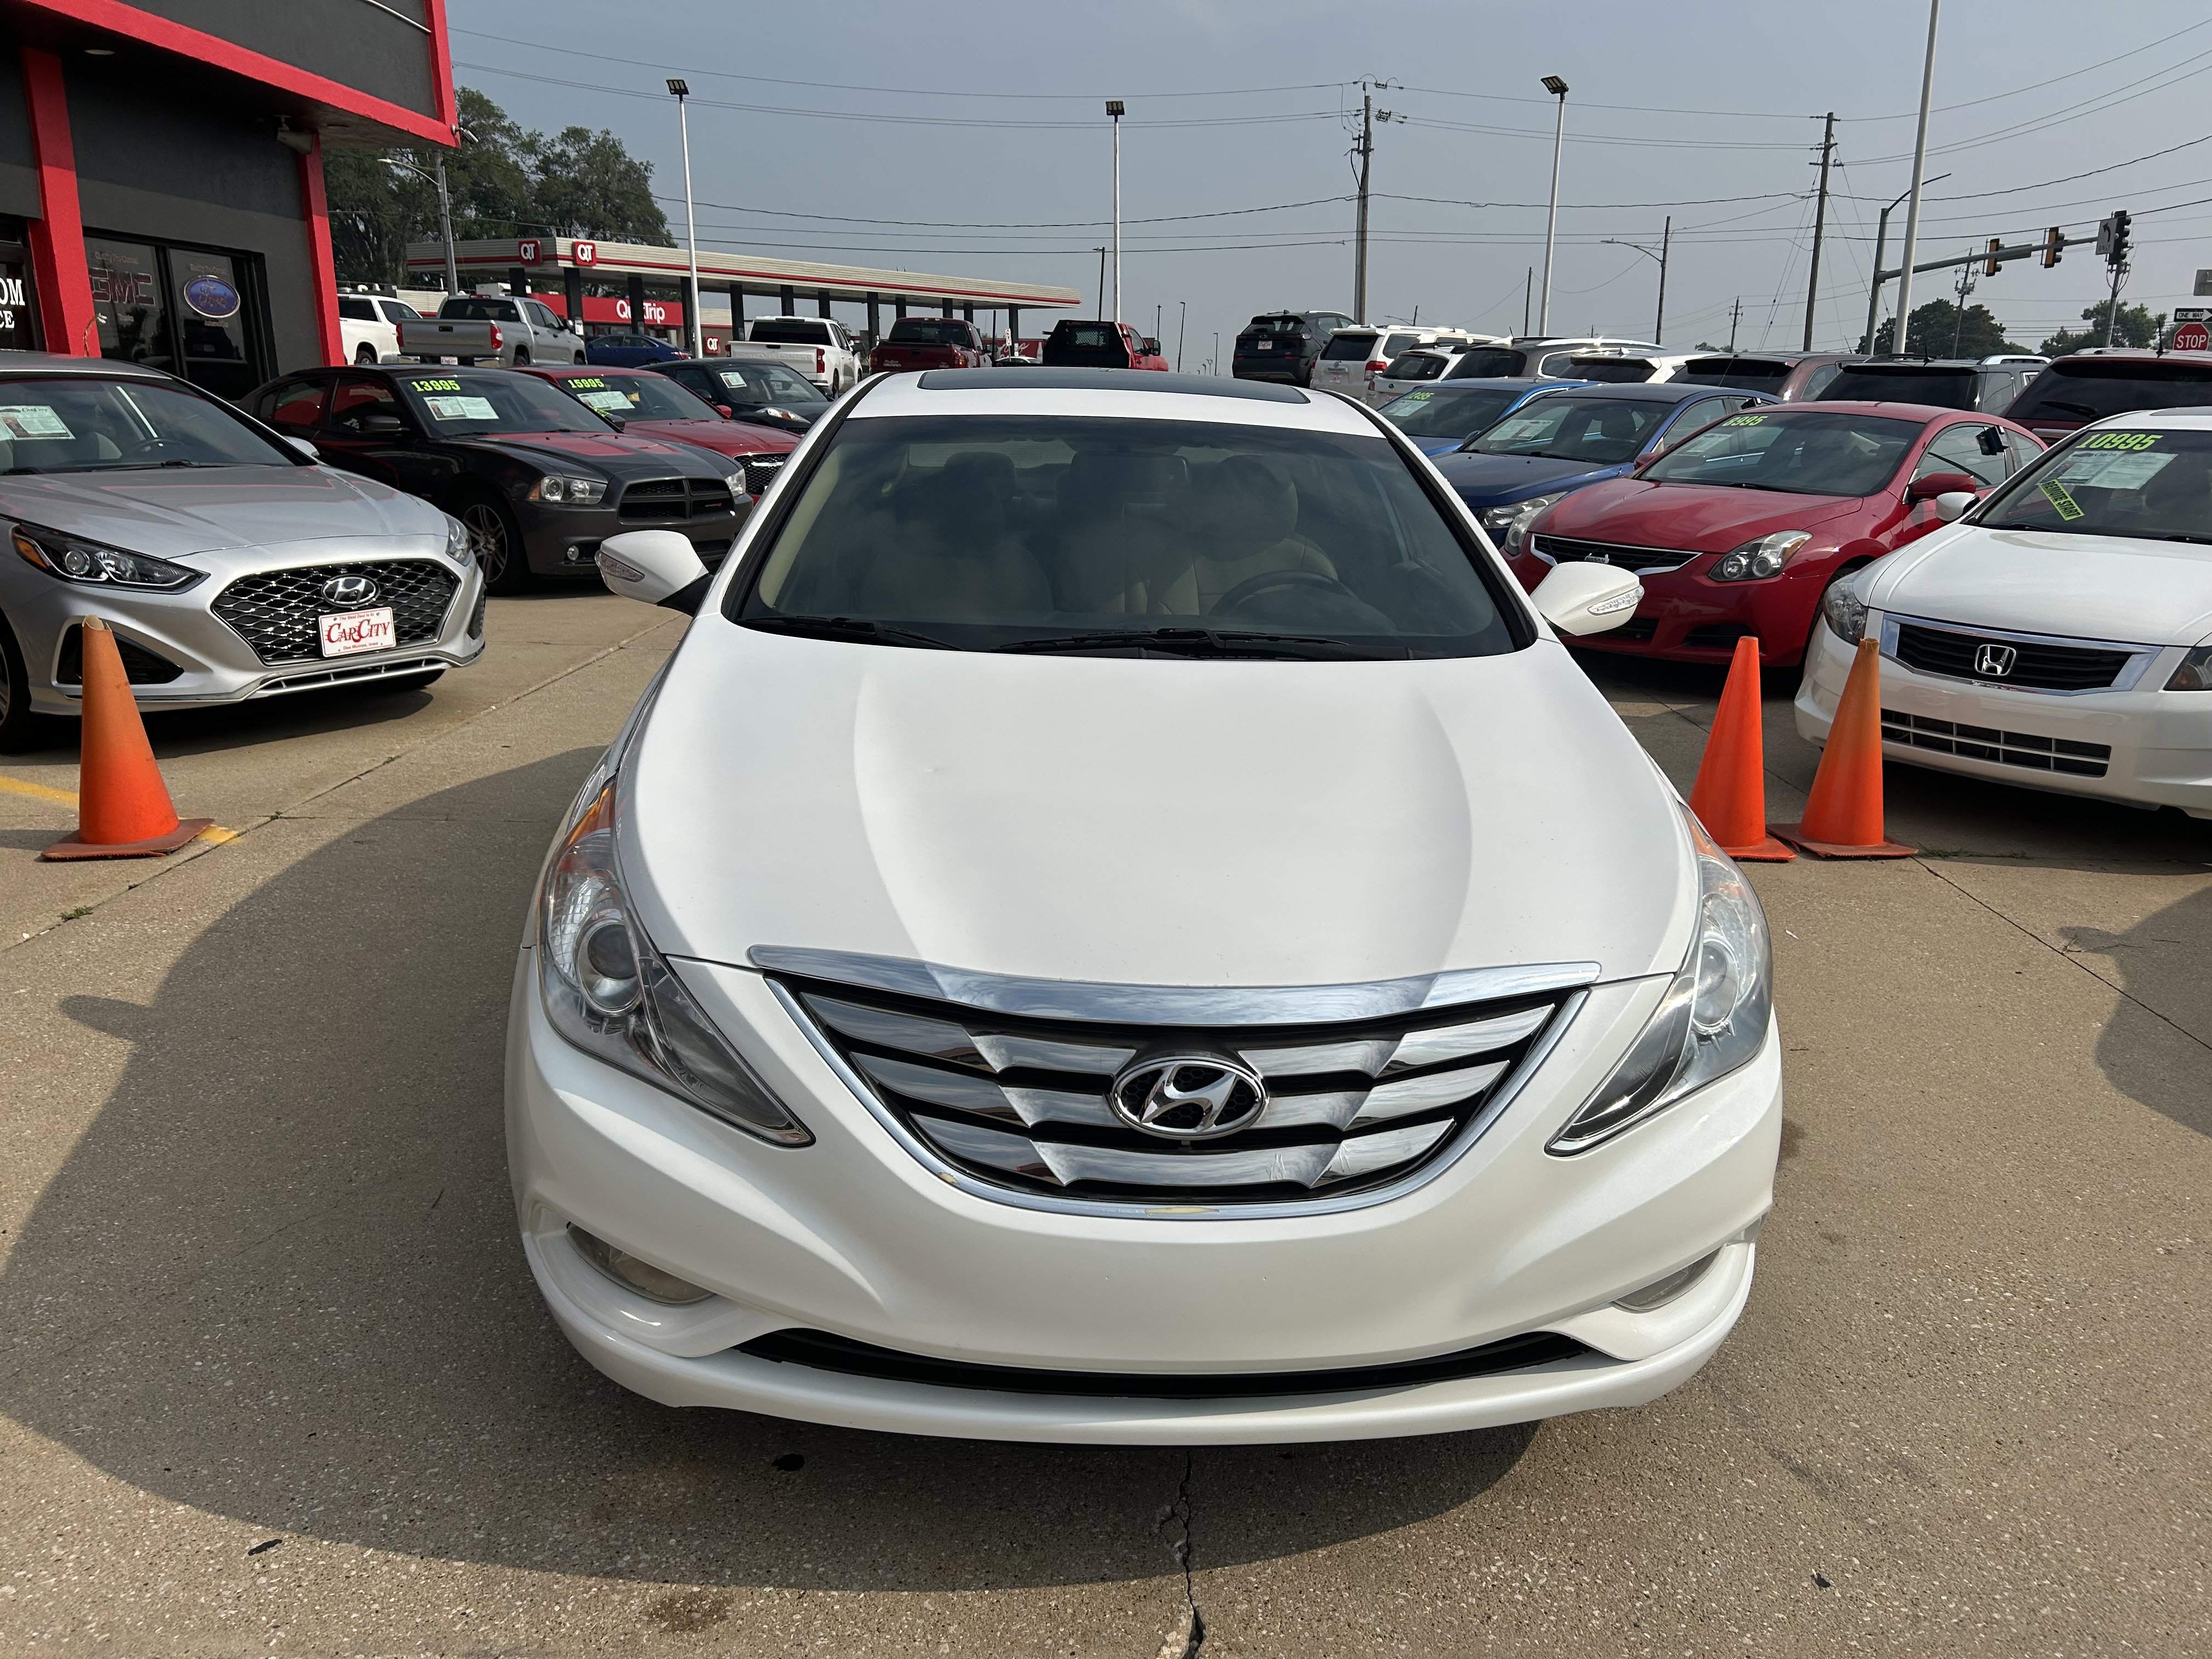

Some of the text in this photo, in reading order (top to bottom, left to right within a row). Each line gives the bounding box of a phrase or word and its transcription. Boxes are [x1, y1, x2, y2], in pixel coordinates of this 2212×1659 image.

[521, 243, 535, 261] QT
[577, 244, 594, 262] QT
[2098, 244, 2112, 252] ONLY
[88, 267, 156, 306] GMC
[616, 299, 665, 324] QTrip
[707, 337, 719, 351] QT
[2176, 335, 2207, 348] STOP
[411, 380, 461, 392] 13995
[1722, 416, 1769, 427] 8995
[2075, 433, 2163, 450] 10995
[2041, 481, 2068, 503] REMOTE
[2057, 500, 2081, 518] START
